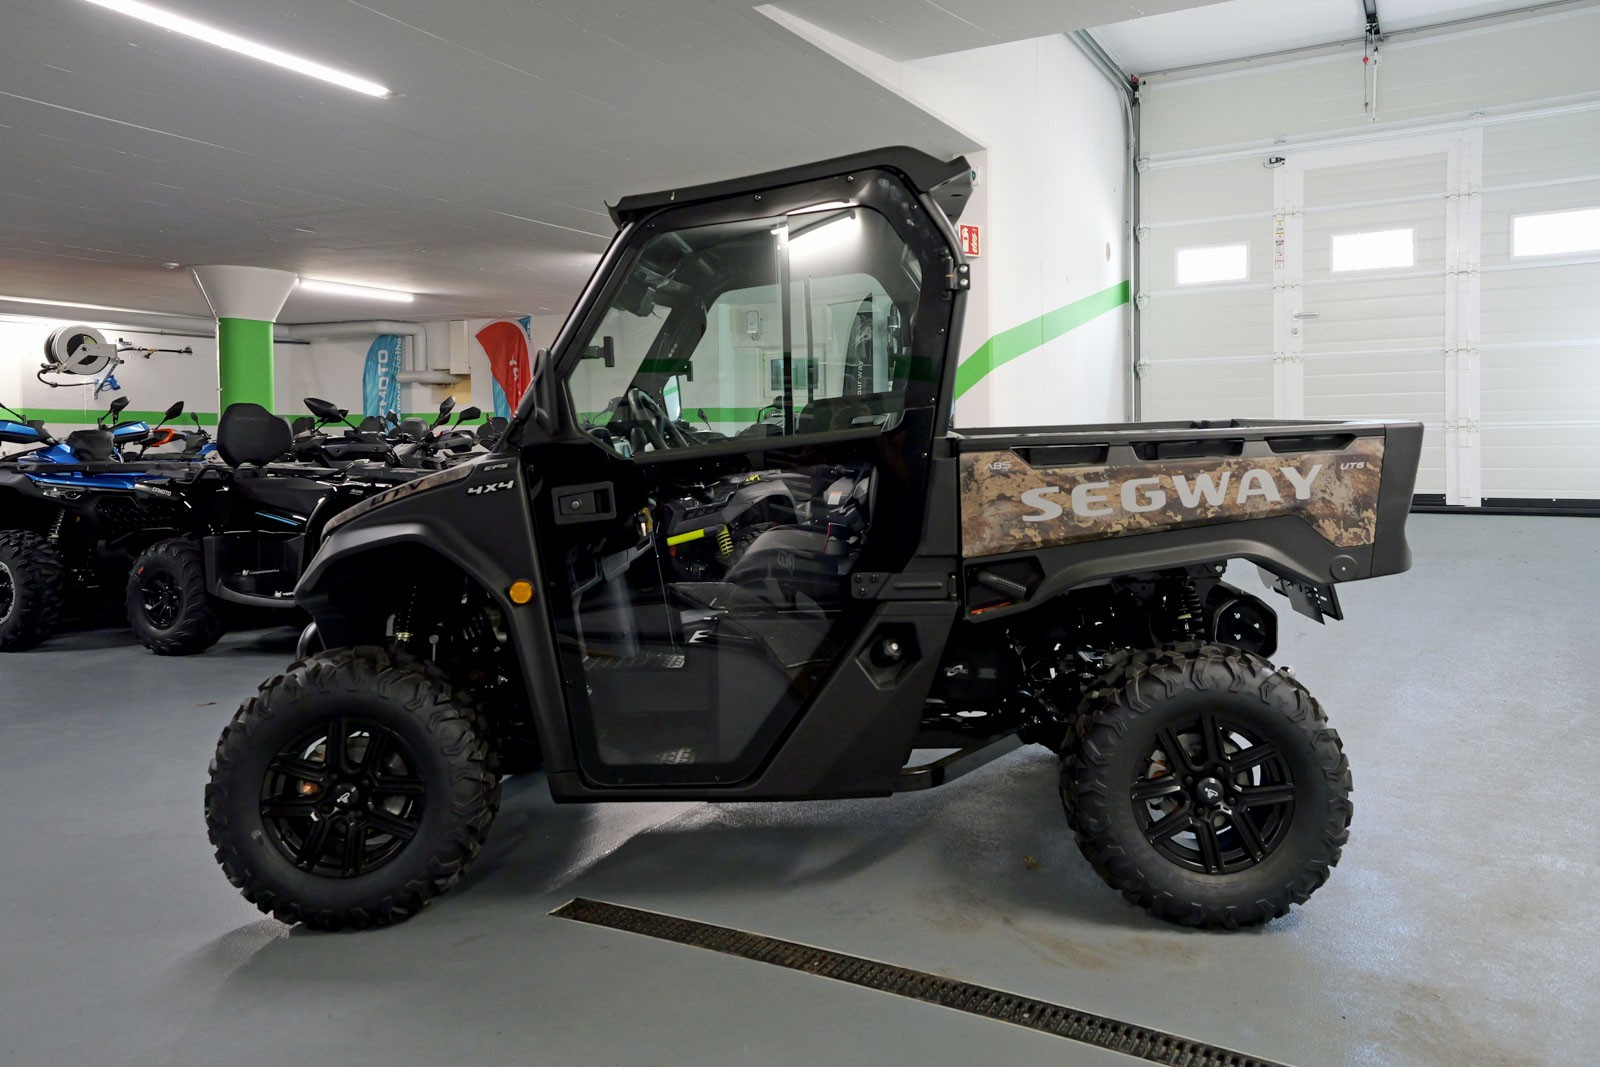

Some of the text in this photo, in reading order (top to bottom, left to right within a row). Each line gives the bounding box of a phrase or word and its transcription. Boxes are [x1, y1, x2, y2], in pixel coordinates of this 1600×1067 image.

[378, 349, 389, 419] FMOTO
[984, 460, 1012, 471] ABS
[1340, 461, 1366, 470] UT6
[1020, 464, 1323, 522] SEGWAY
